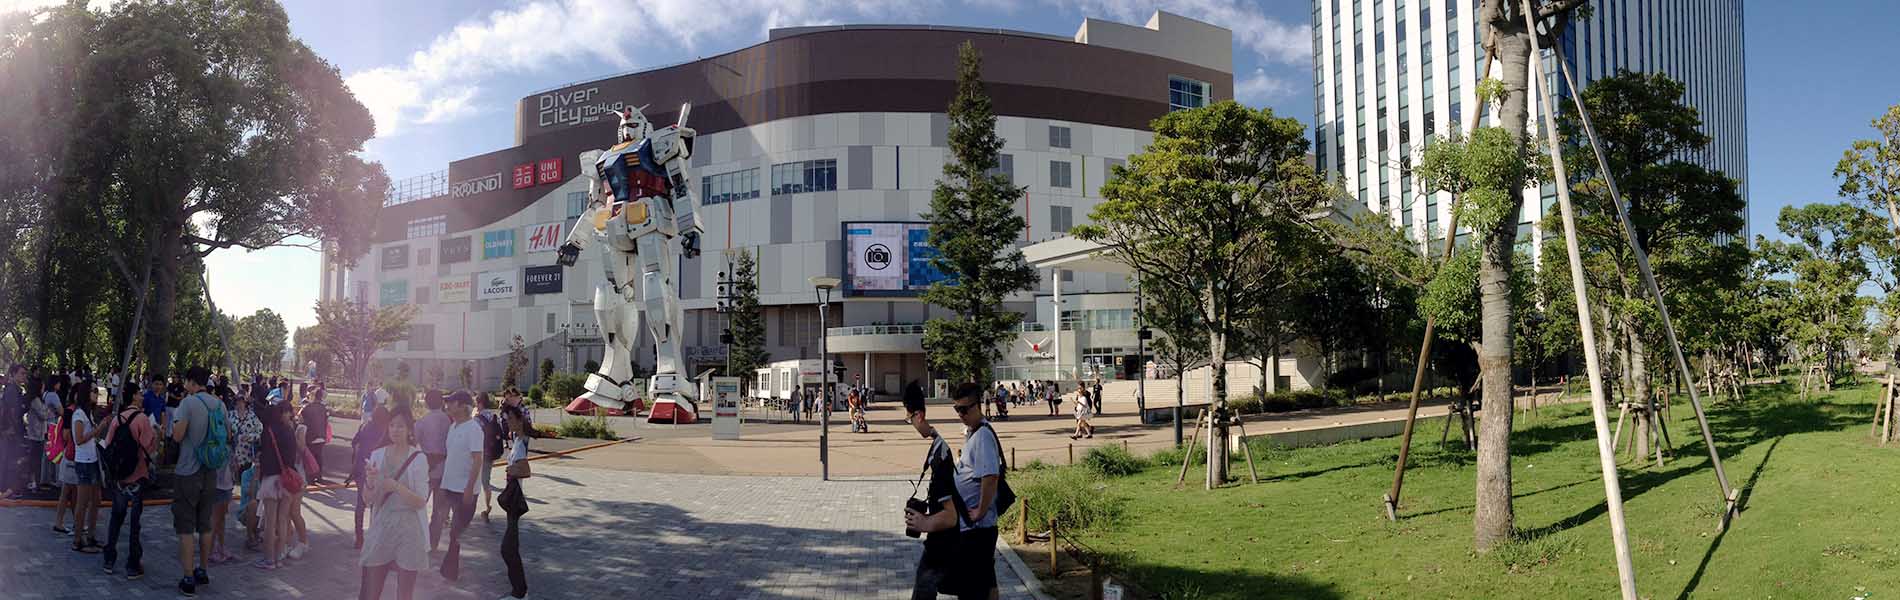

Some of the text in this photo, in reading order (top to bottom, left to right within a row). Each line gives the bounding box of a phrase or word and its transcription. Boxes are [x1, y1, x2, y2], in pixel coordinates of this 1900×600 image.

[540, 87, 599, 111] Diver
[540, 106, 581, 126] City
[541, 160, 557, 171] UNI
[541, 171, 557, 182] QLO
[529, 223, 560, 250] H&M
[526, 272, 560, 283] FOREVER 21
[483, 286, 512, 294] LACOSTE
